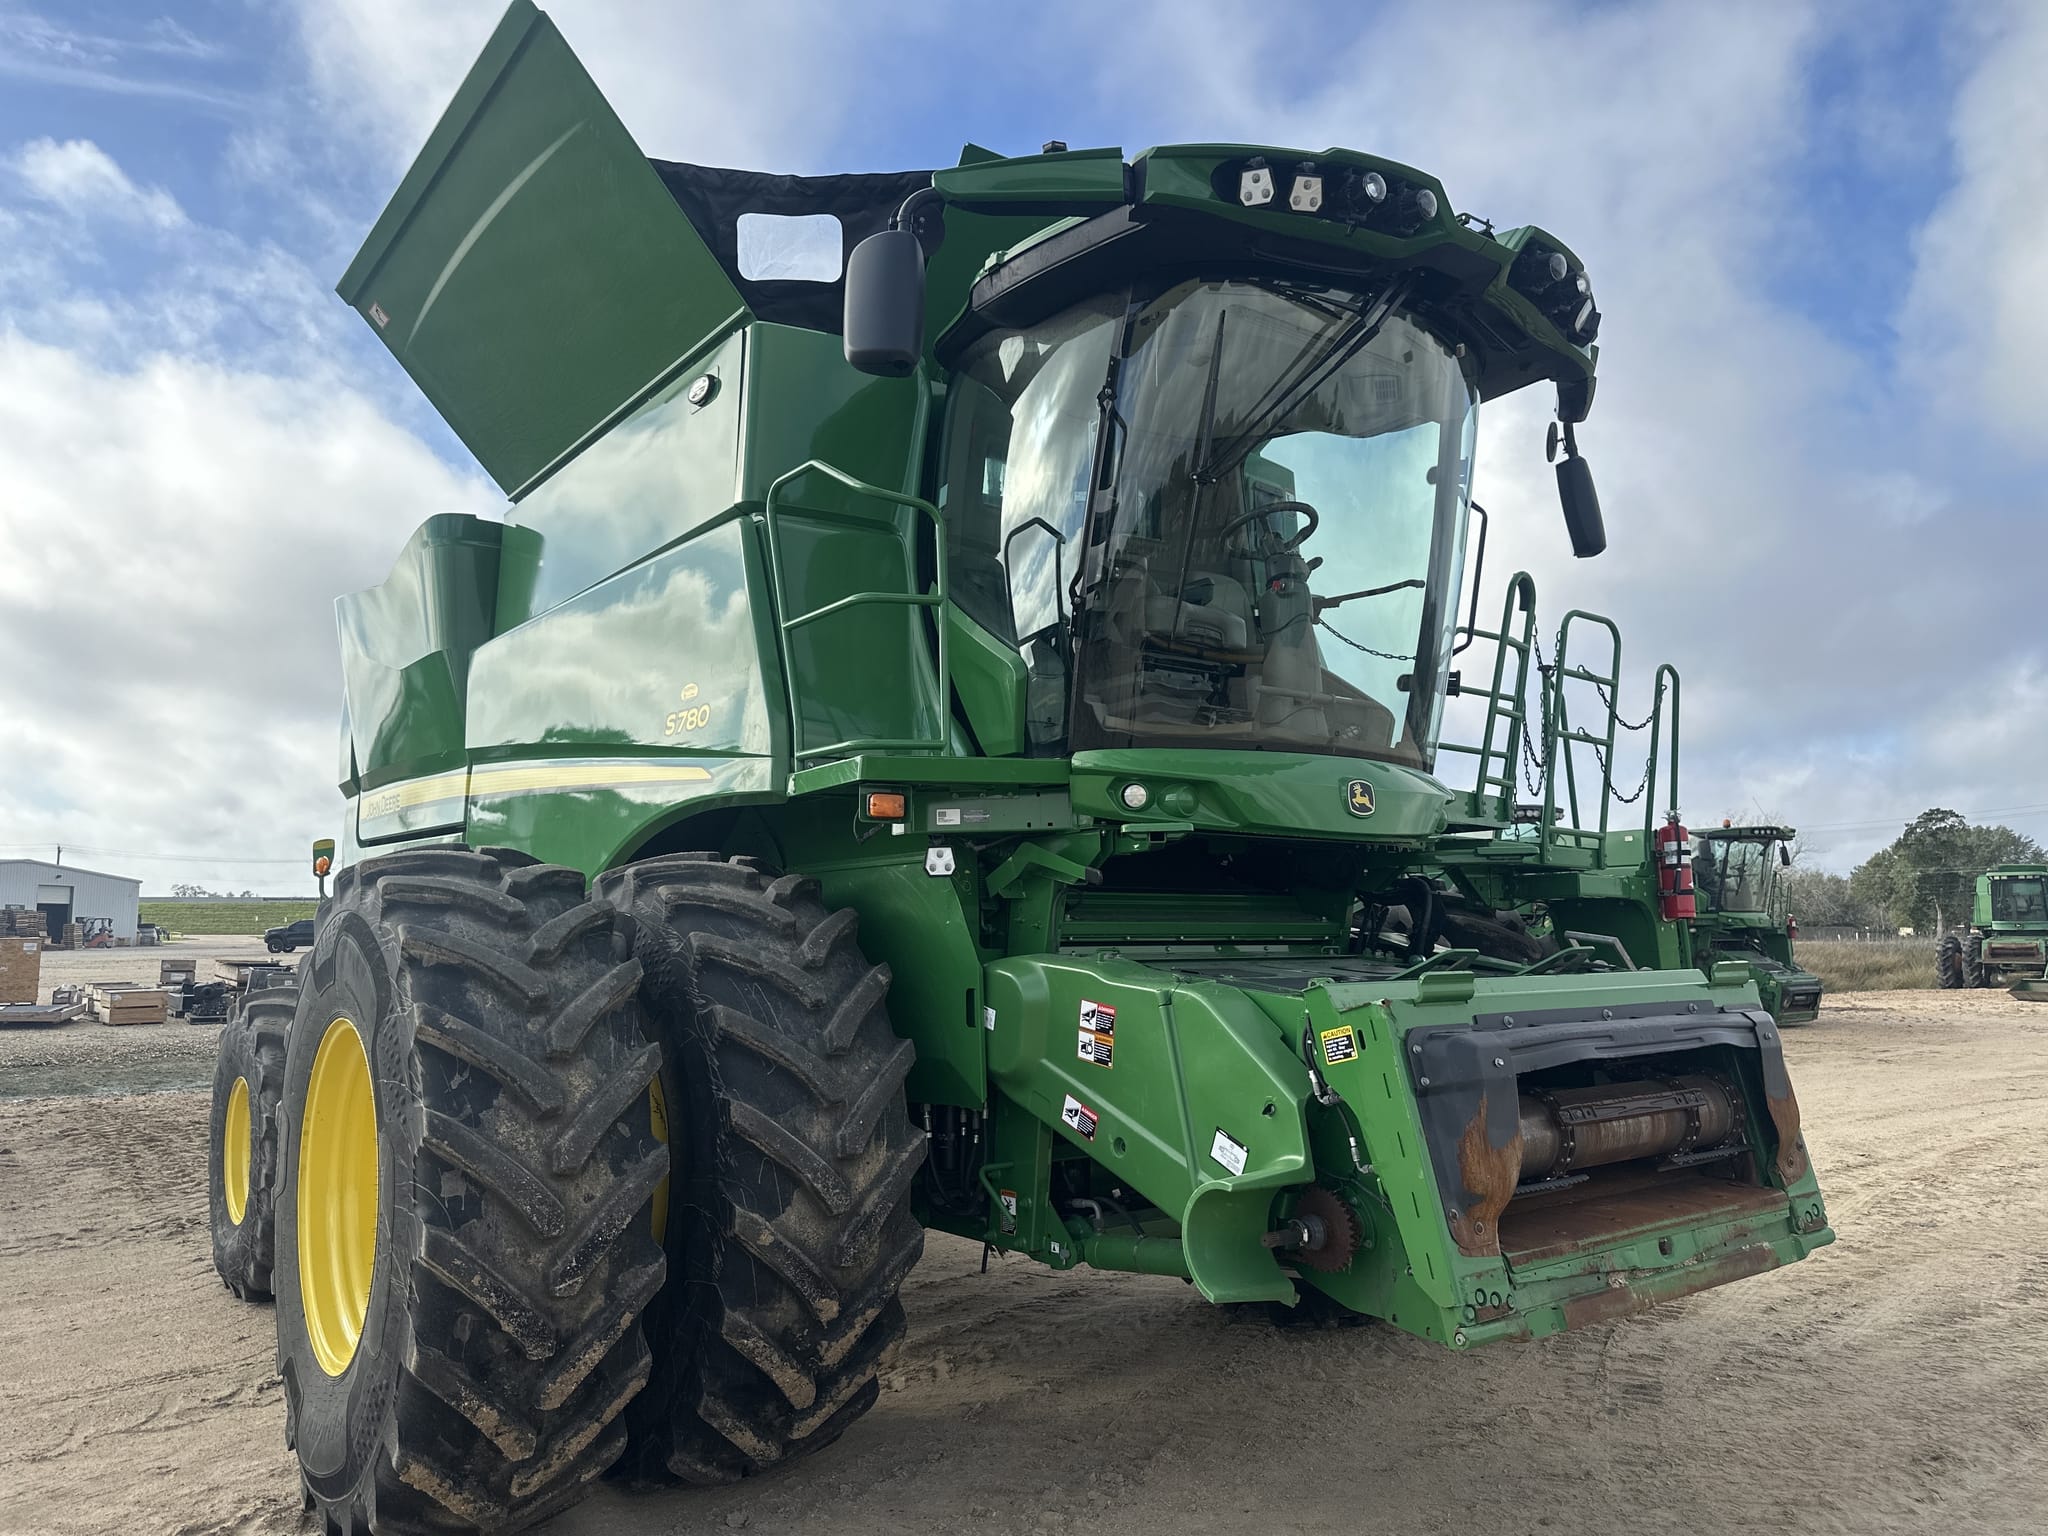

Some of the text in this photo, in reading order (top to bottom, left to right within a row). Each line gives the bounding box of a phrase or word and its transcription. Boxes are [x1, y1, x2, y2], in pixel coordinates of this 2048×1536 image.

[664, 703, 711, 736] S780
[381, 794, 401, 813] DEERE
[1326, 1027, 1351, 1038] CAUTION
